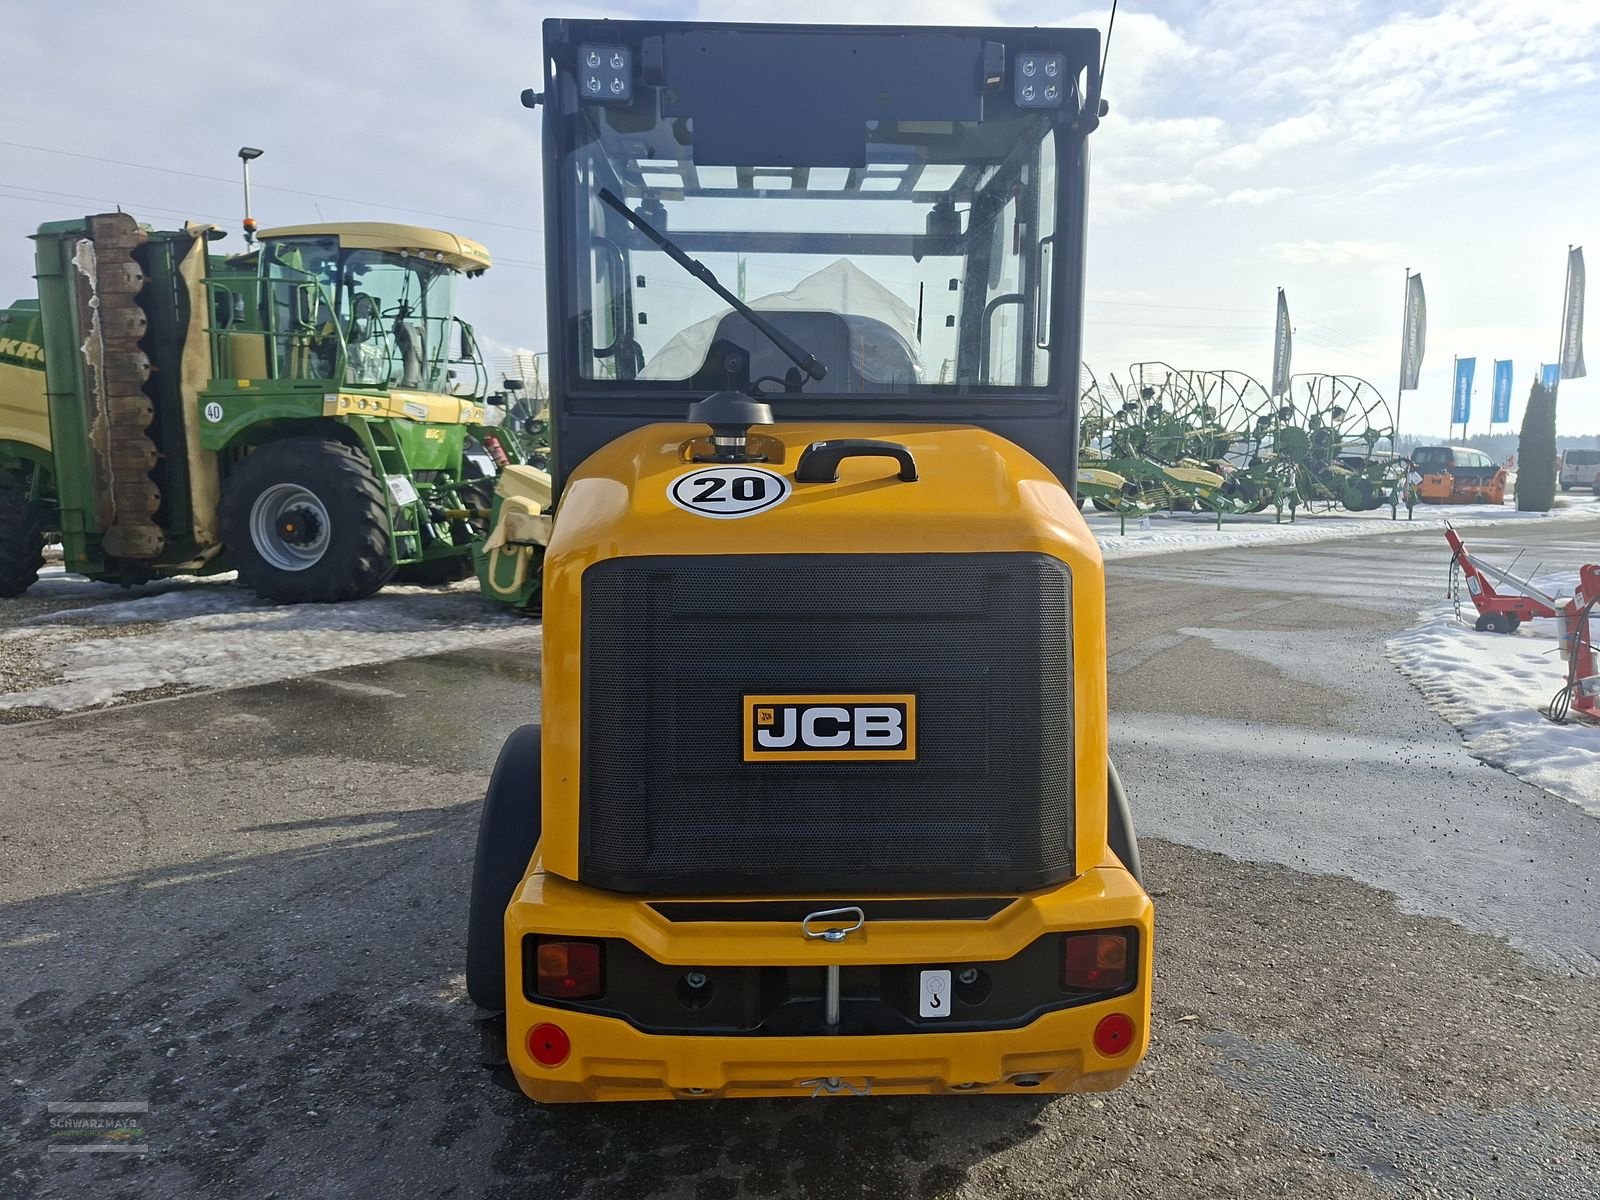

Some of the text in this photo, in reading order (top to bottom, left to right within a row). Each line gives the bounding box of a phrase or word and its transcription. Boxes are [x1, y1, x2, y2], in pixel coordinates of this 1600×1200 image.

[207, 405, 220, 419] 40
[692, 476, 766, 502] 20
[757, 707, 903, 748] JCB
